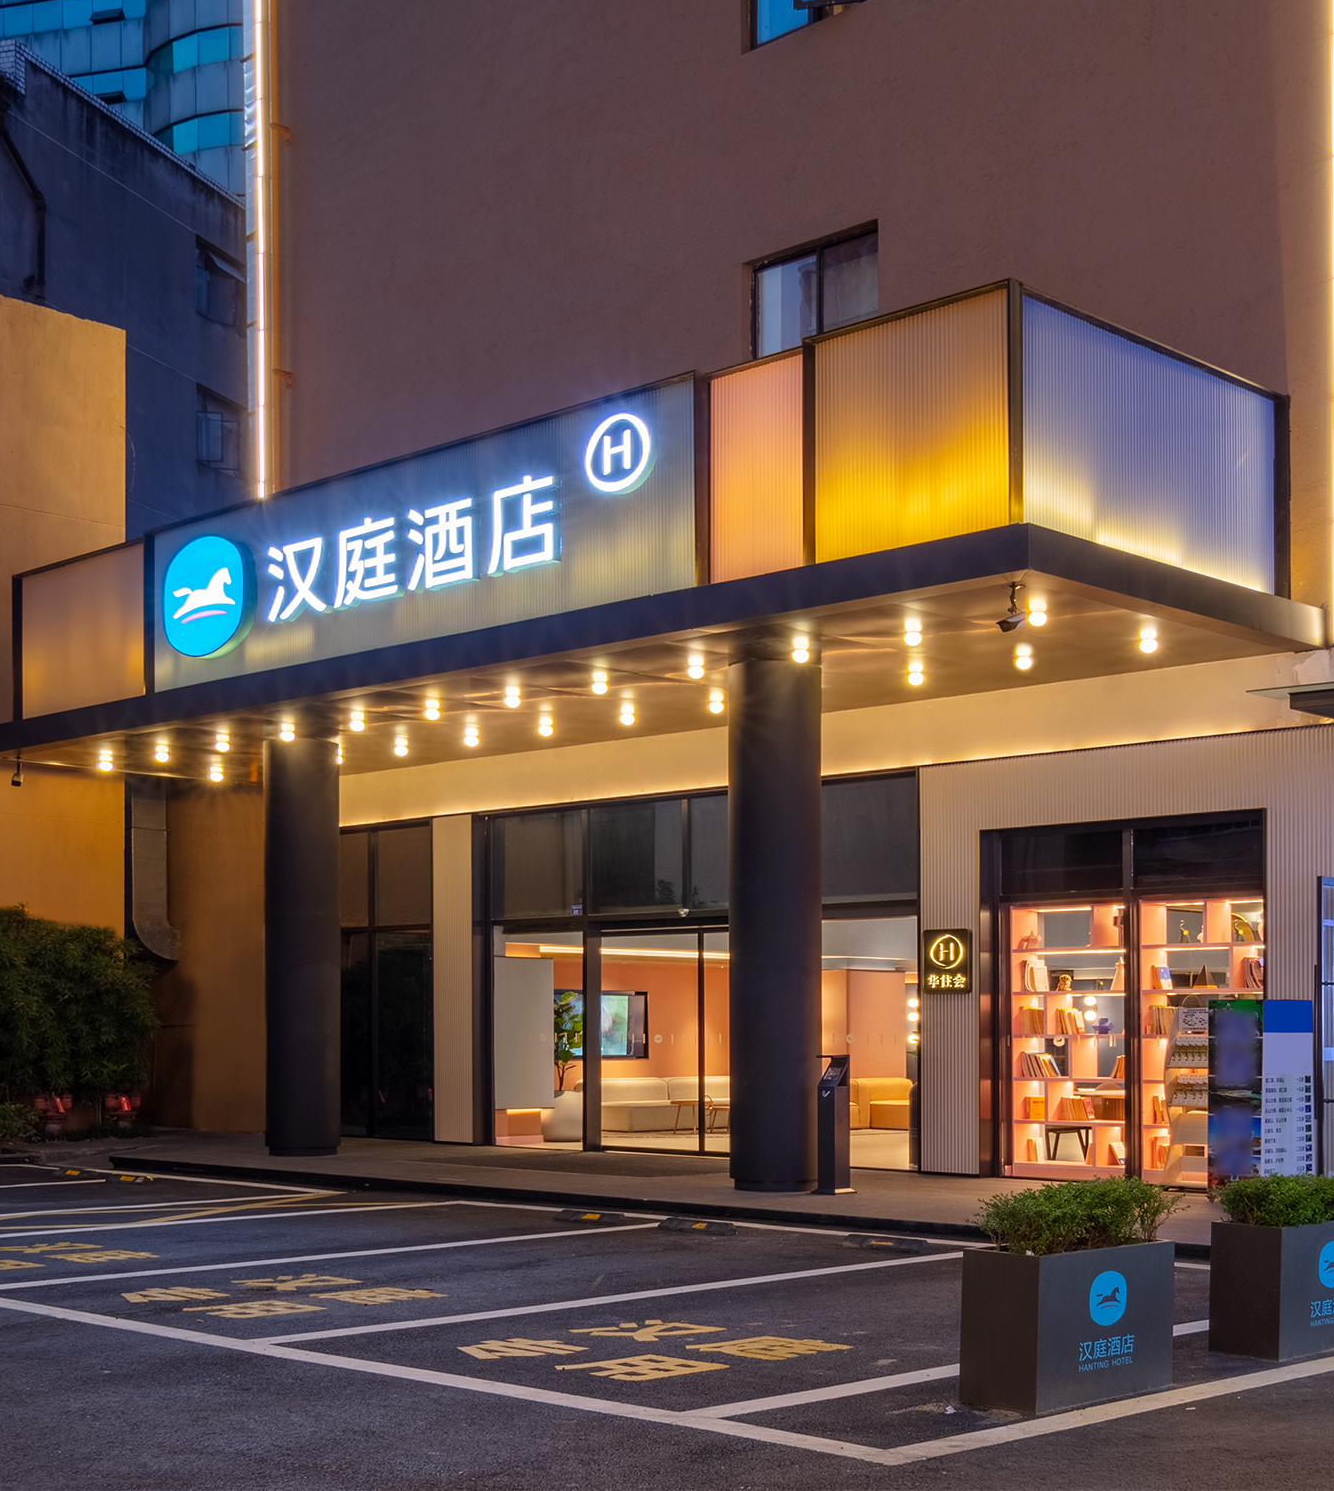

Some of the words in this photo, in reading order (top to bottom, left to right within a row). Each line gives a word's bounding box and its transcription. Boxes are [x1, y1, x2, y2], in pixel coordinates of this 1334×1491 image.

[267, 474, 556, 623] 汉庭酒店
[927, 974, 966, 989] 华住会
[1310, 1317, 1334, 1327] HANTING
[1078, 1334, 1135, 1361] 汉庭酒店
[1078, 1360, 1109, 1373] HANTING
[1112, 1356, 1133, 1366] HOTEL
